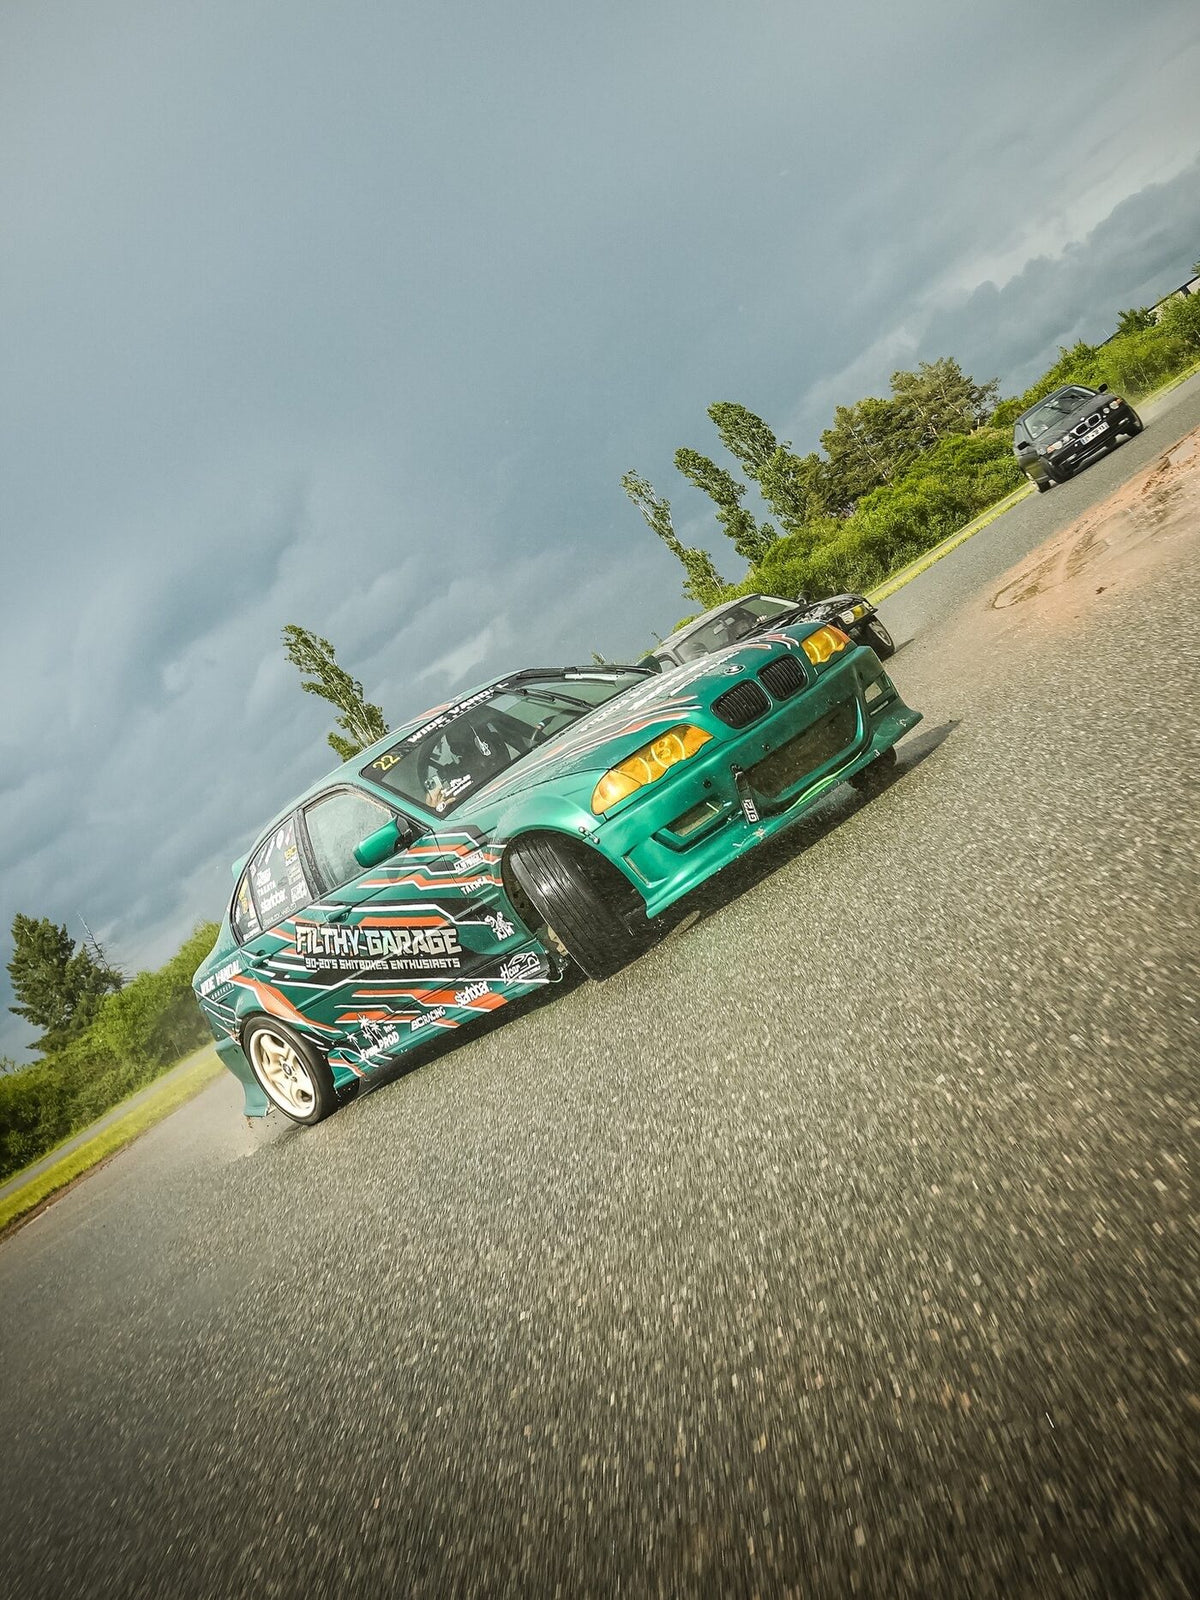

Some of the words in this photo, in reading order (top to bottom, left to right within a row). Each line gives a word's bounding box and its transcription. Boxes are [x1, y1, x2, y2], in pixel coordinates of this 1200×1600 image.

[407, 714, 447, 742] WIDE
[373, 754, 400, 771] 22
[295, 926, 360, 955] FILTHY
[363, 928, 463, 956] GARAGE
[339, 958, 388, 971] SHITBOXES
[390, 957, 462, 970] ENTHUSIASTS
